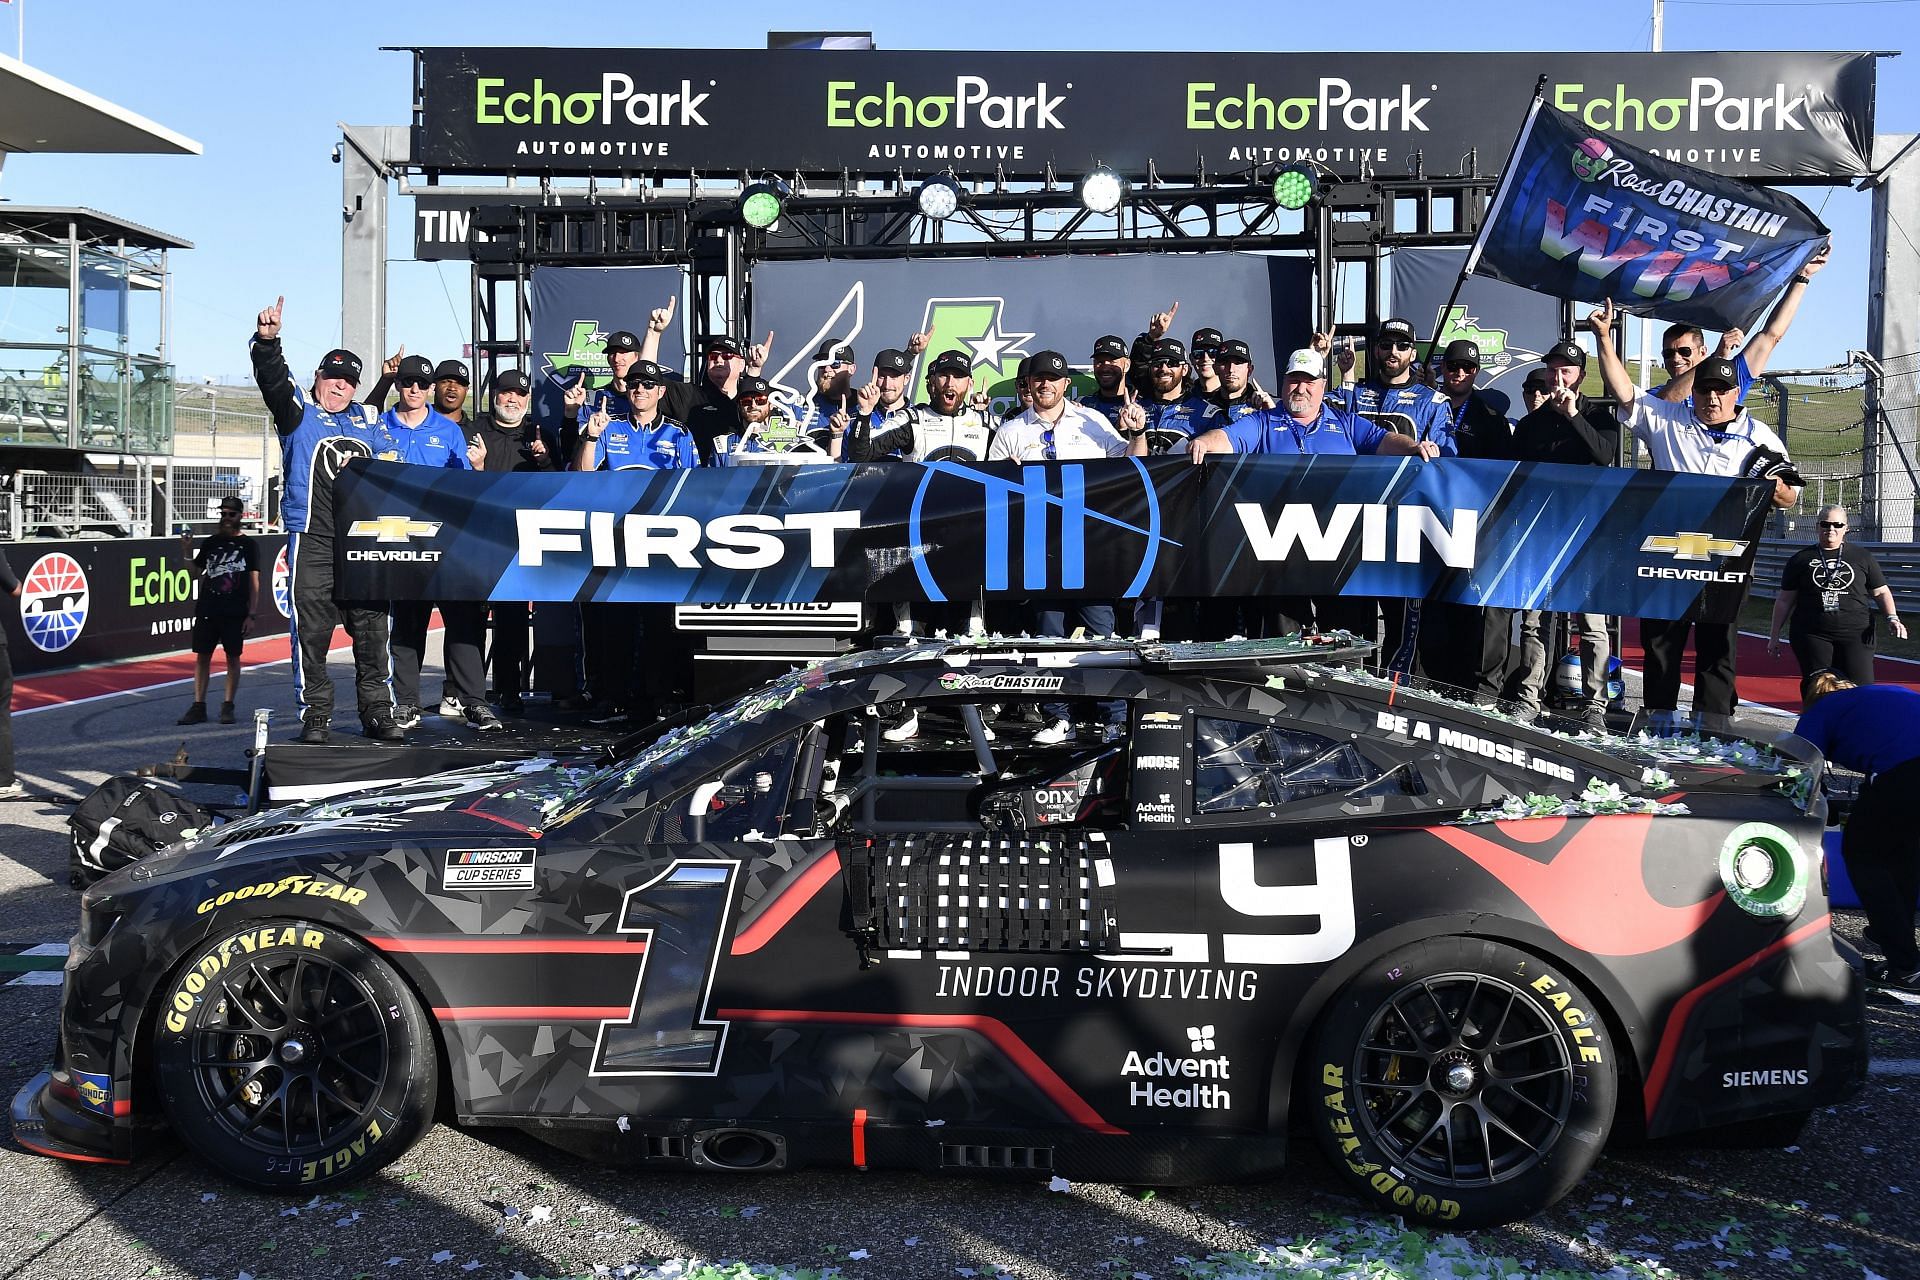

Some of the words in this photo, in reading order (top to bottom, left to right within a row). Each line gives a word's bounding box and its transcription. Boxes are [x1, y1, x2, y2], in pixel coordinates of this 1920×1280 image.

[476, 72, 710, 126] EchoPark
[827, 75, 1067, 129] EchoPark
[1186, 77, 1431, 131] EchoPark
[1555, 77, 1805, 132] EchoPark
[516, 141, 669, 156] AUTOMOTIVE
[868, 144, 1025, 160] AUTOMOTIVE
[1228, 147, 1388, 162] AUTOMOTIVE
[1662, 179, 1789, 238] CHASTAIN
[419, 210, 496, 243] TIM
[515, 509, 861, 570] FIRST
[1234, 502, 1479, 569] WIN
[346, 549, 443, 562] CHEVROLET
[130, 549, 200, 607] Echo
[1637, 566, 1747, 584] CHEVROLET
[994, 676, 1061, 688] CHASTAIN
[1376, 711, 1408, 735] BE
[1413, 721, 1432, 741] A
[1136, 755, 1180, 768] MOOSE
[1035, 789, 1074, 804] onx
[1136, 802, 1175, 814] Advent
[1138, 812, 1175, 823] Health
[474, 851, 523, 864] NASCAR
[457, 869, 480, 881] CUP
[481, 868, 522, 881] SERIES
[197, 875, 368, 914] GOODYEAR
[166, 927, 325, 1033] GOODYEAR
[588, 858, 742, 1077] 1
[935, 965, 1060, 997] INDOOR
[1075, 968, 1259, 1002] SKYDIVING
[1530, 973, 1603, 1064] EAGLE
[1120, 1051, 1230, 1079] Advent
[1722, 1069, 1809, 1088] SIEMENS
[79, 1085, 110, 1101] SUNOCO
[1130, 1080, 1231, 1110] Health
[301, 1119, 384, 1182] EAGLE
[1323, 1063, 1461, 1220] GOODYEAR
